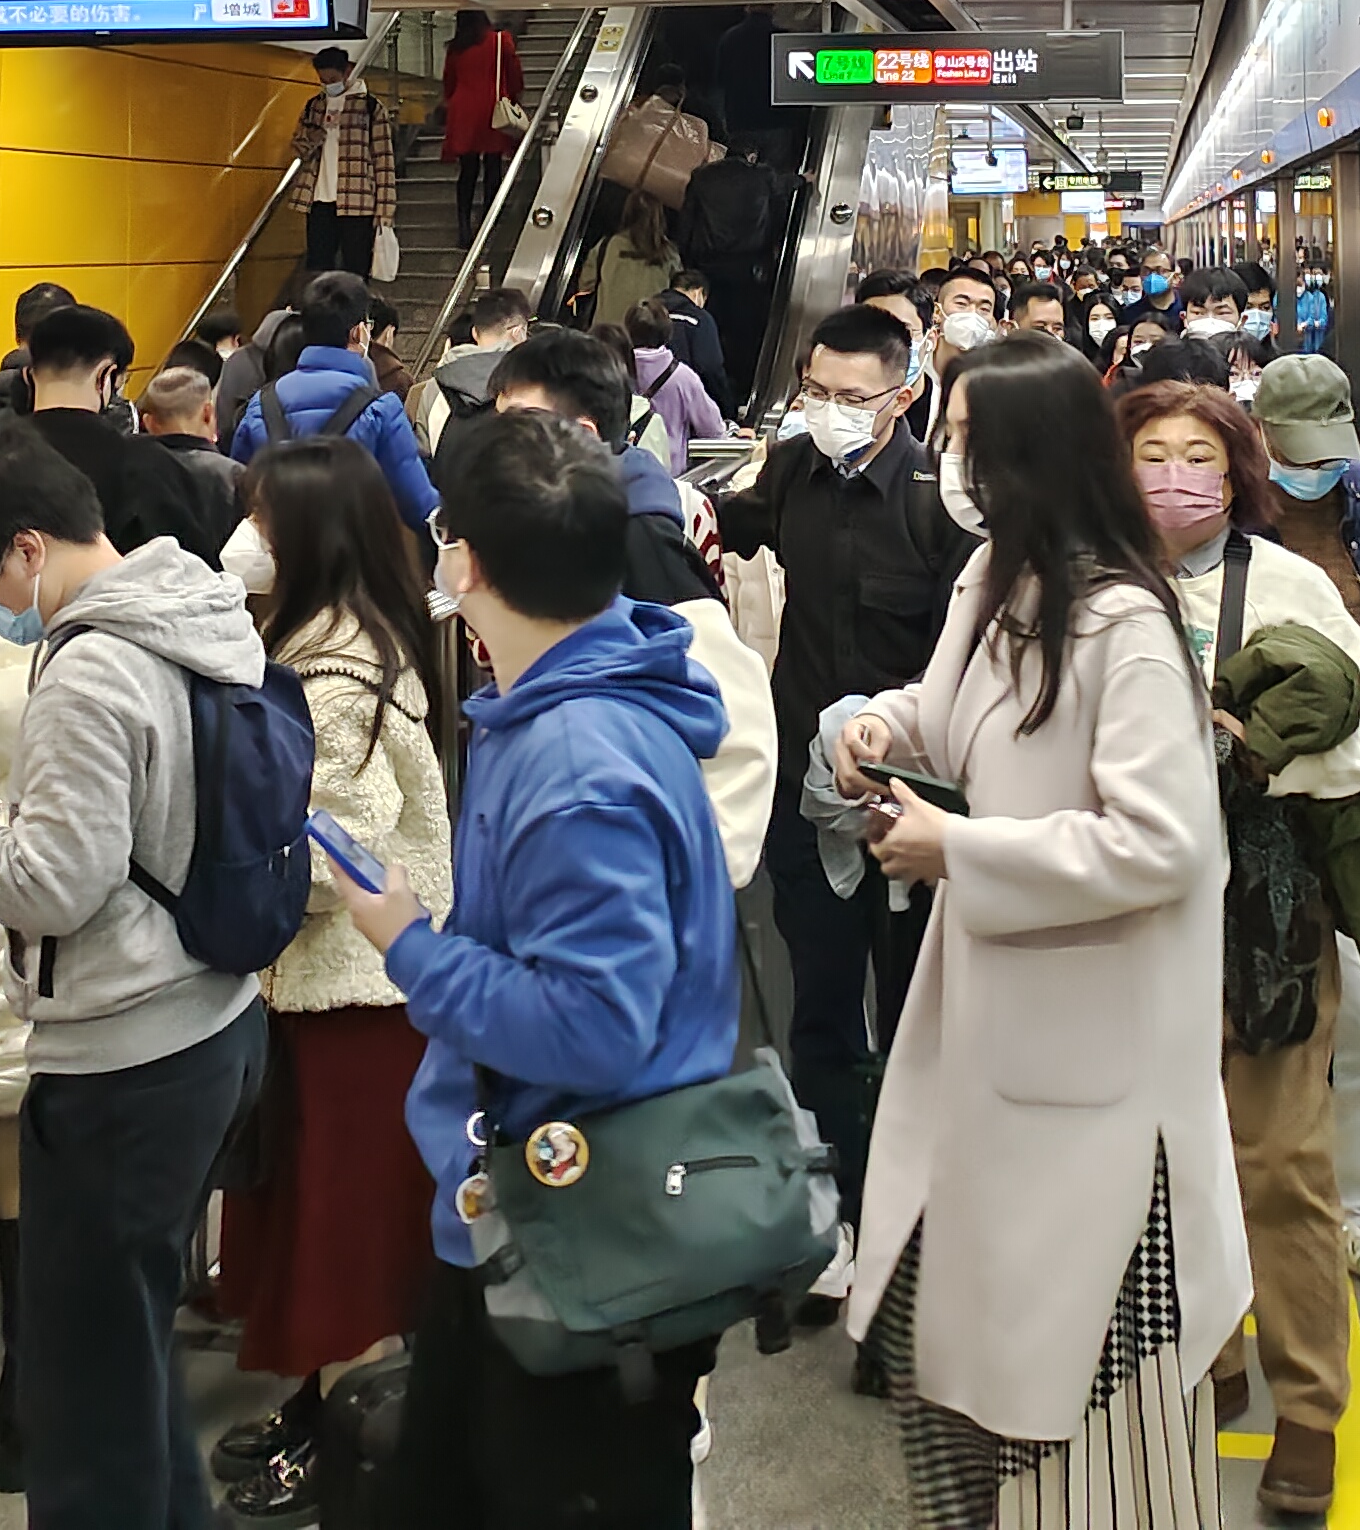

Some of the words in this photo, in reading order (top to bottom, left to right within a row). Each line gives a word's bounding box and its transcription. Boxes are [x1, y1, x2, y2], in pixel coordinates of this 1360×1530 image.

[223, 3, 262, 16] 增城
[877, 51, 930, 70] 22号线
[992, 48, 1039, 73] 出站
[877, 70, 900, 82] Line
[901, 70, 916, 81] 22
[992, 73, 1018, 85] Exit
